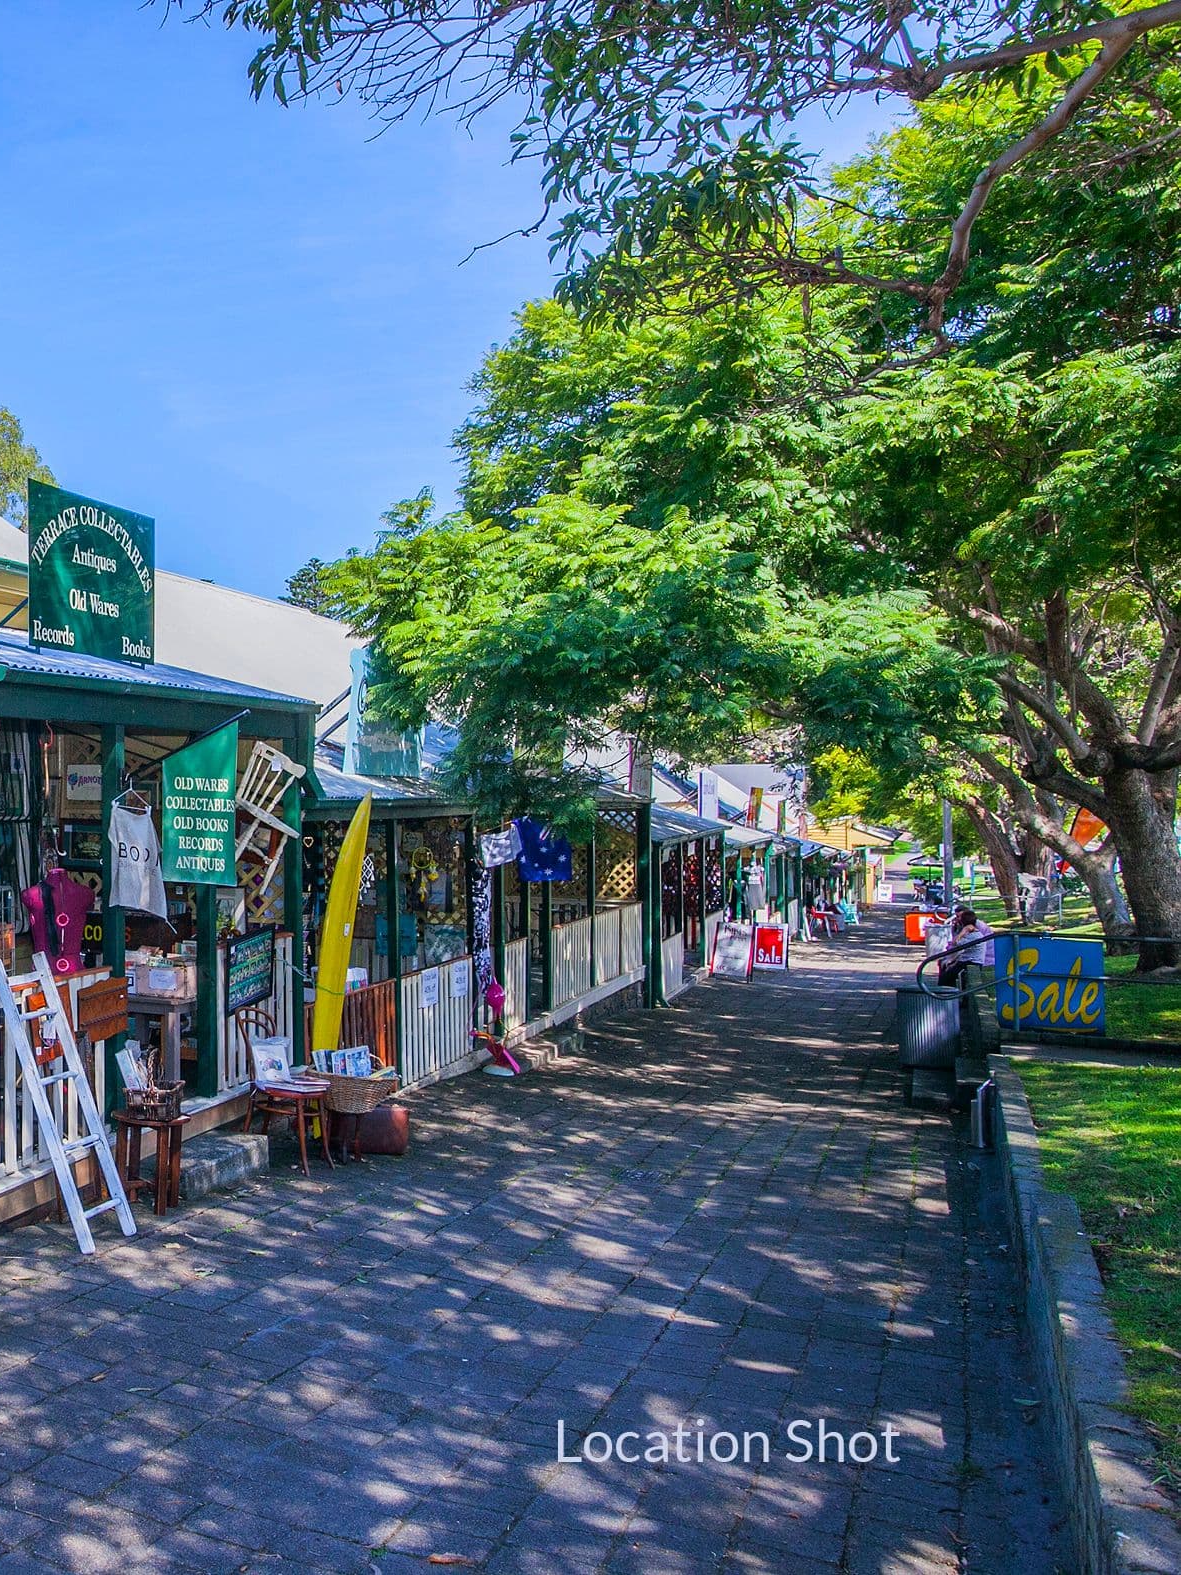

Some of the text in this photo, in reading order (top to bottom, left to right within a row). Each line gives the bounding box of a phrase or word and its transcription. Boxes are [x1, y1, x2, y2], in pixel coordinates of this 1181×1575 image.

[31, 505, 153, 593] TERRACE COLLECTABLES
[72, 544, 117, 574] Antiques
[69, 588, 120, 618] Old Wares
[33, 619, 74, 646] Records
[122, 636, 151, 659] Books
[174, 777, 229, 792] OLD WARES
[165, 796, 235, 812] COLLECTABLES
[173, 816, 229, 832] OLD BOOKS
[178, 836, 224, 851] RECORDS
[175, 858, 225, 873] ANTIQUES
[1001, 947, 1100, 1024] Sale
